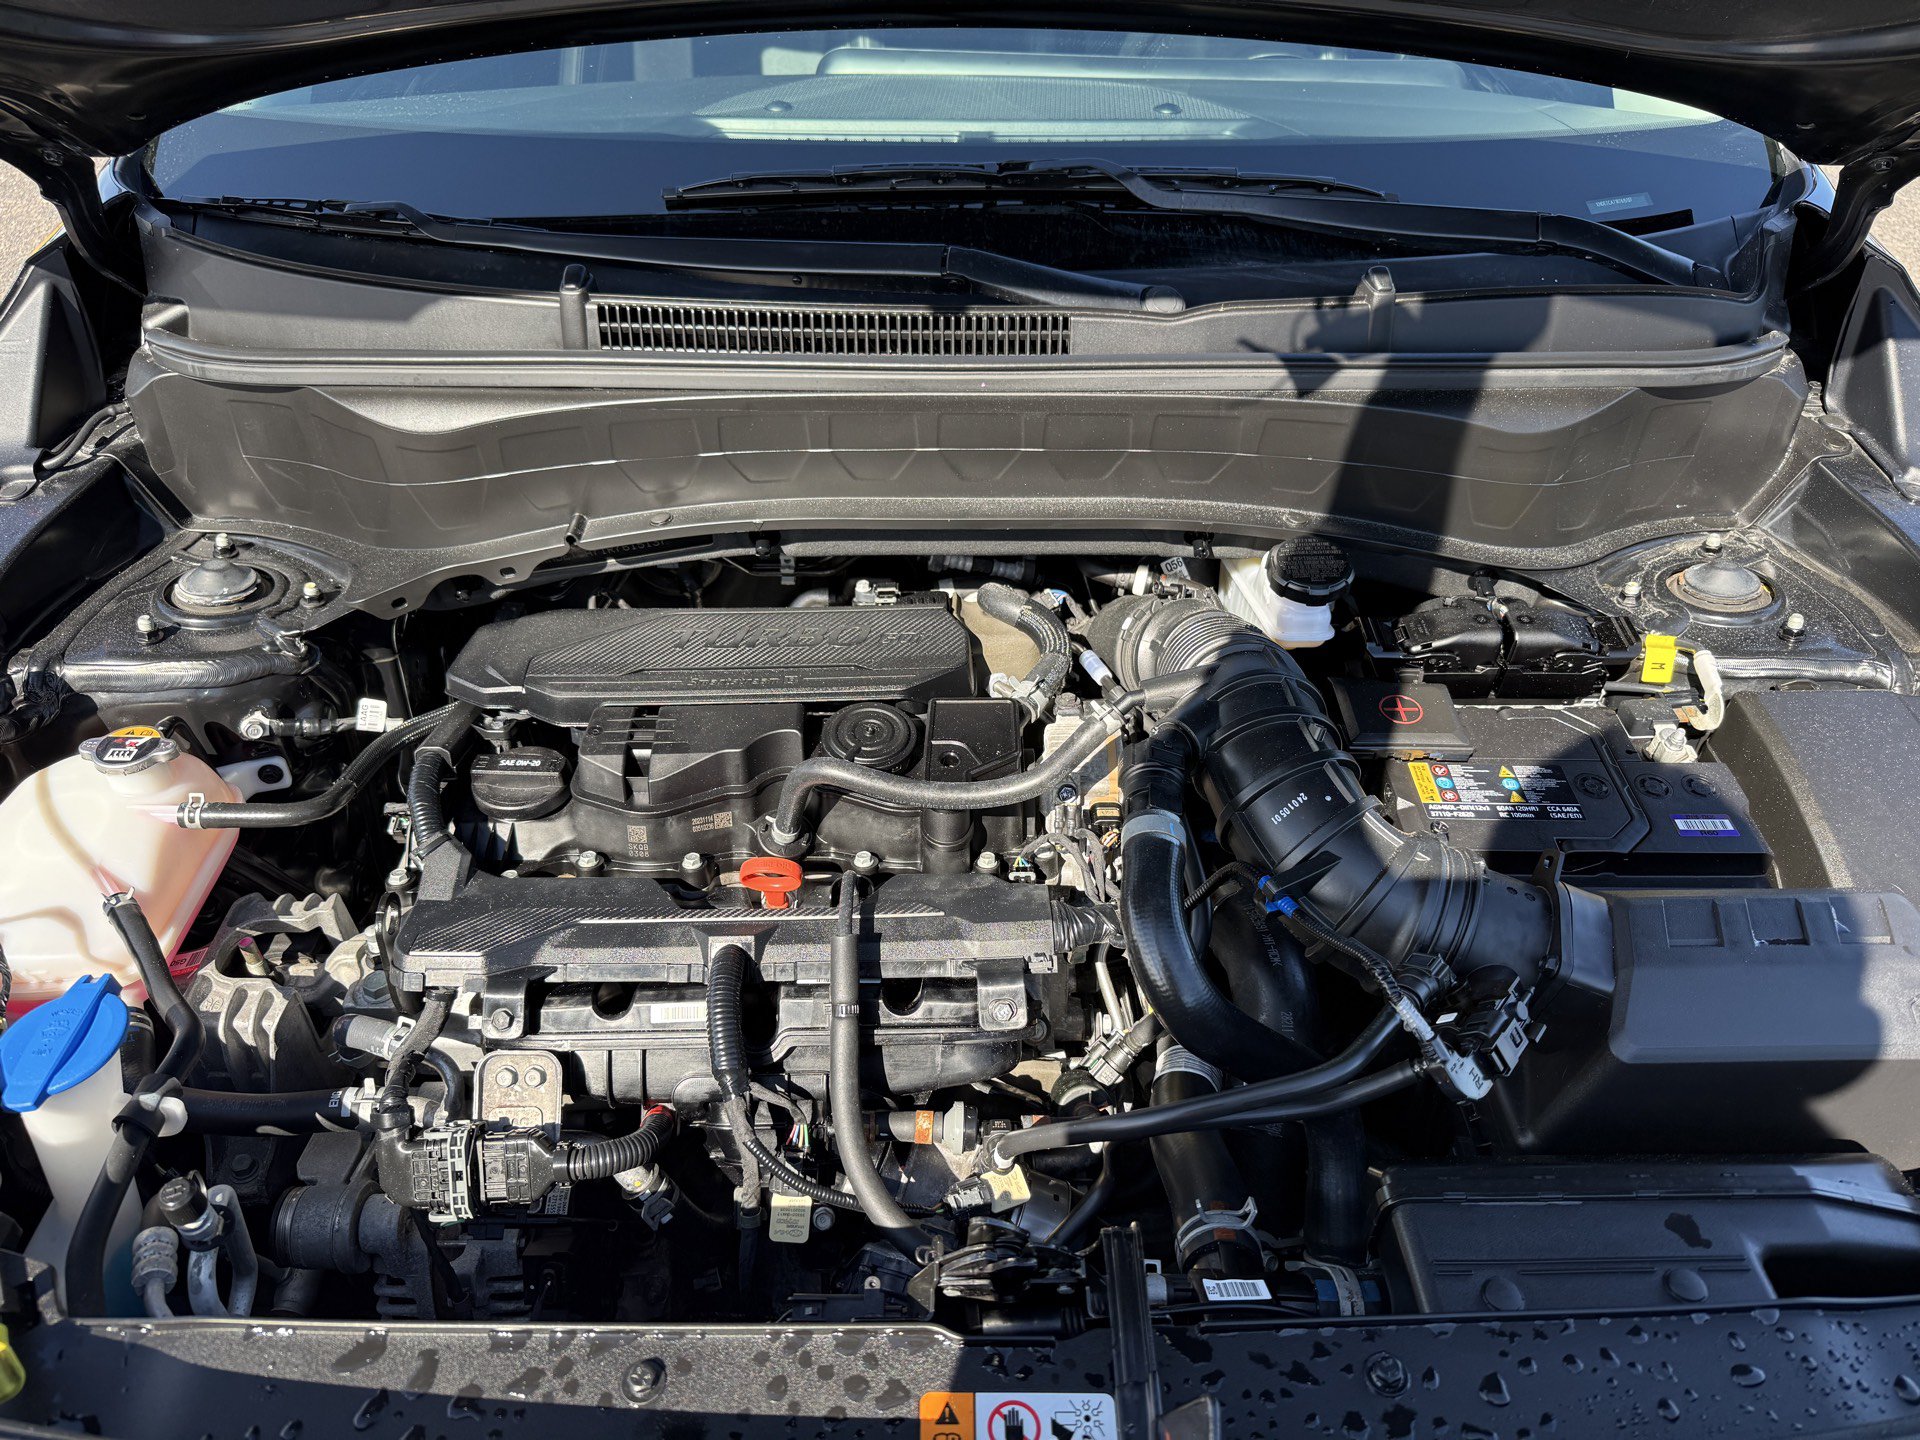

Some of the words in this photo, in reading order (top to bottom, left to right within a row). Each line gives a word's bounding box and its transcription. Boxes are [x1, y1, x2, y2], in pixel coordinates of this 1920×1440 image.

[1164, 557, 1183, 572] Q56
[672, 625, 872, 650] TURBO
[360, 704, 369, 726] LAAG
[1469, 1067, 1484, 1090] RH
